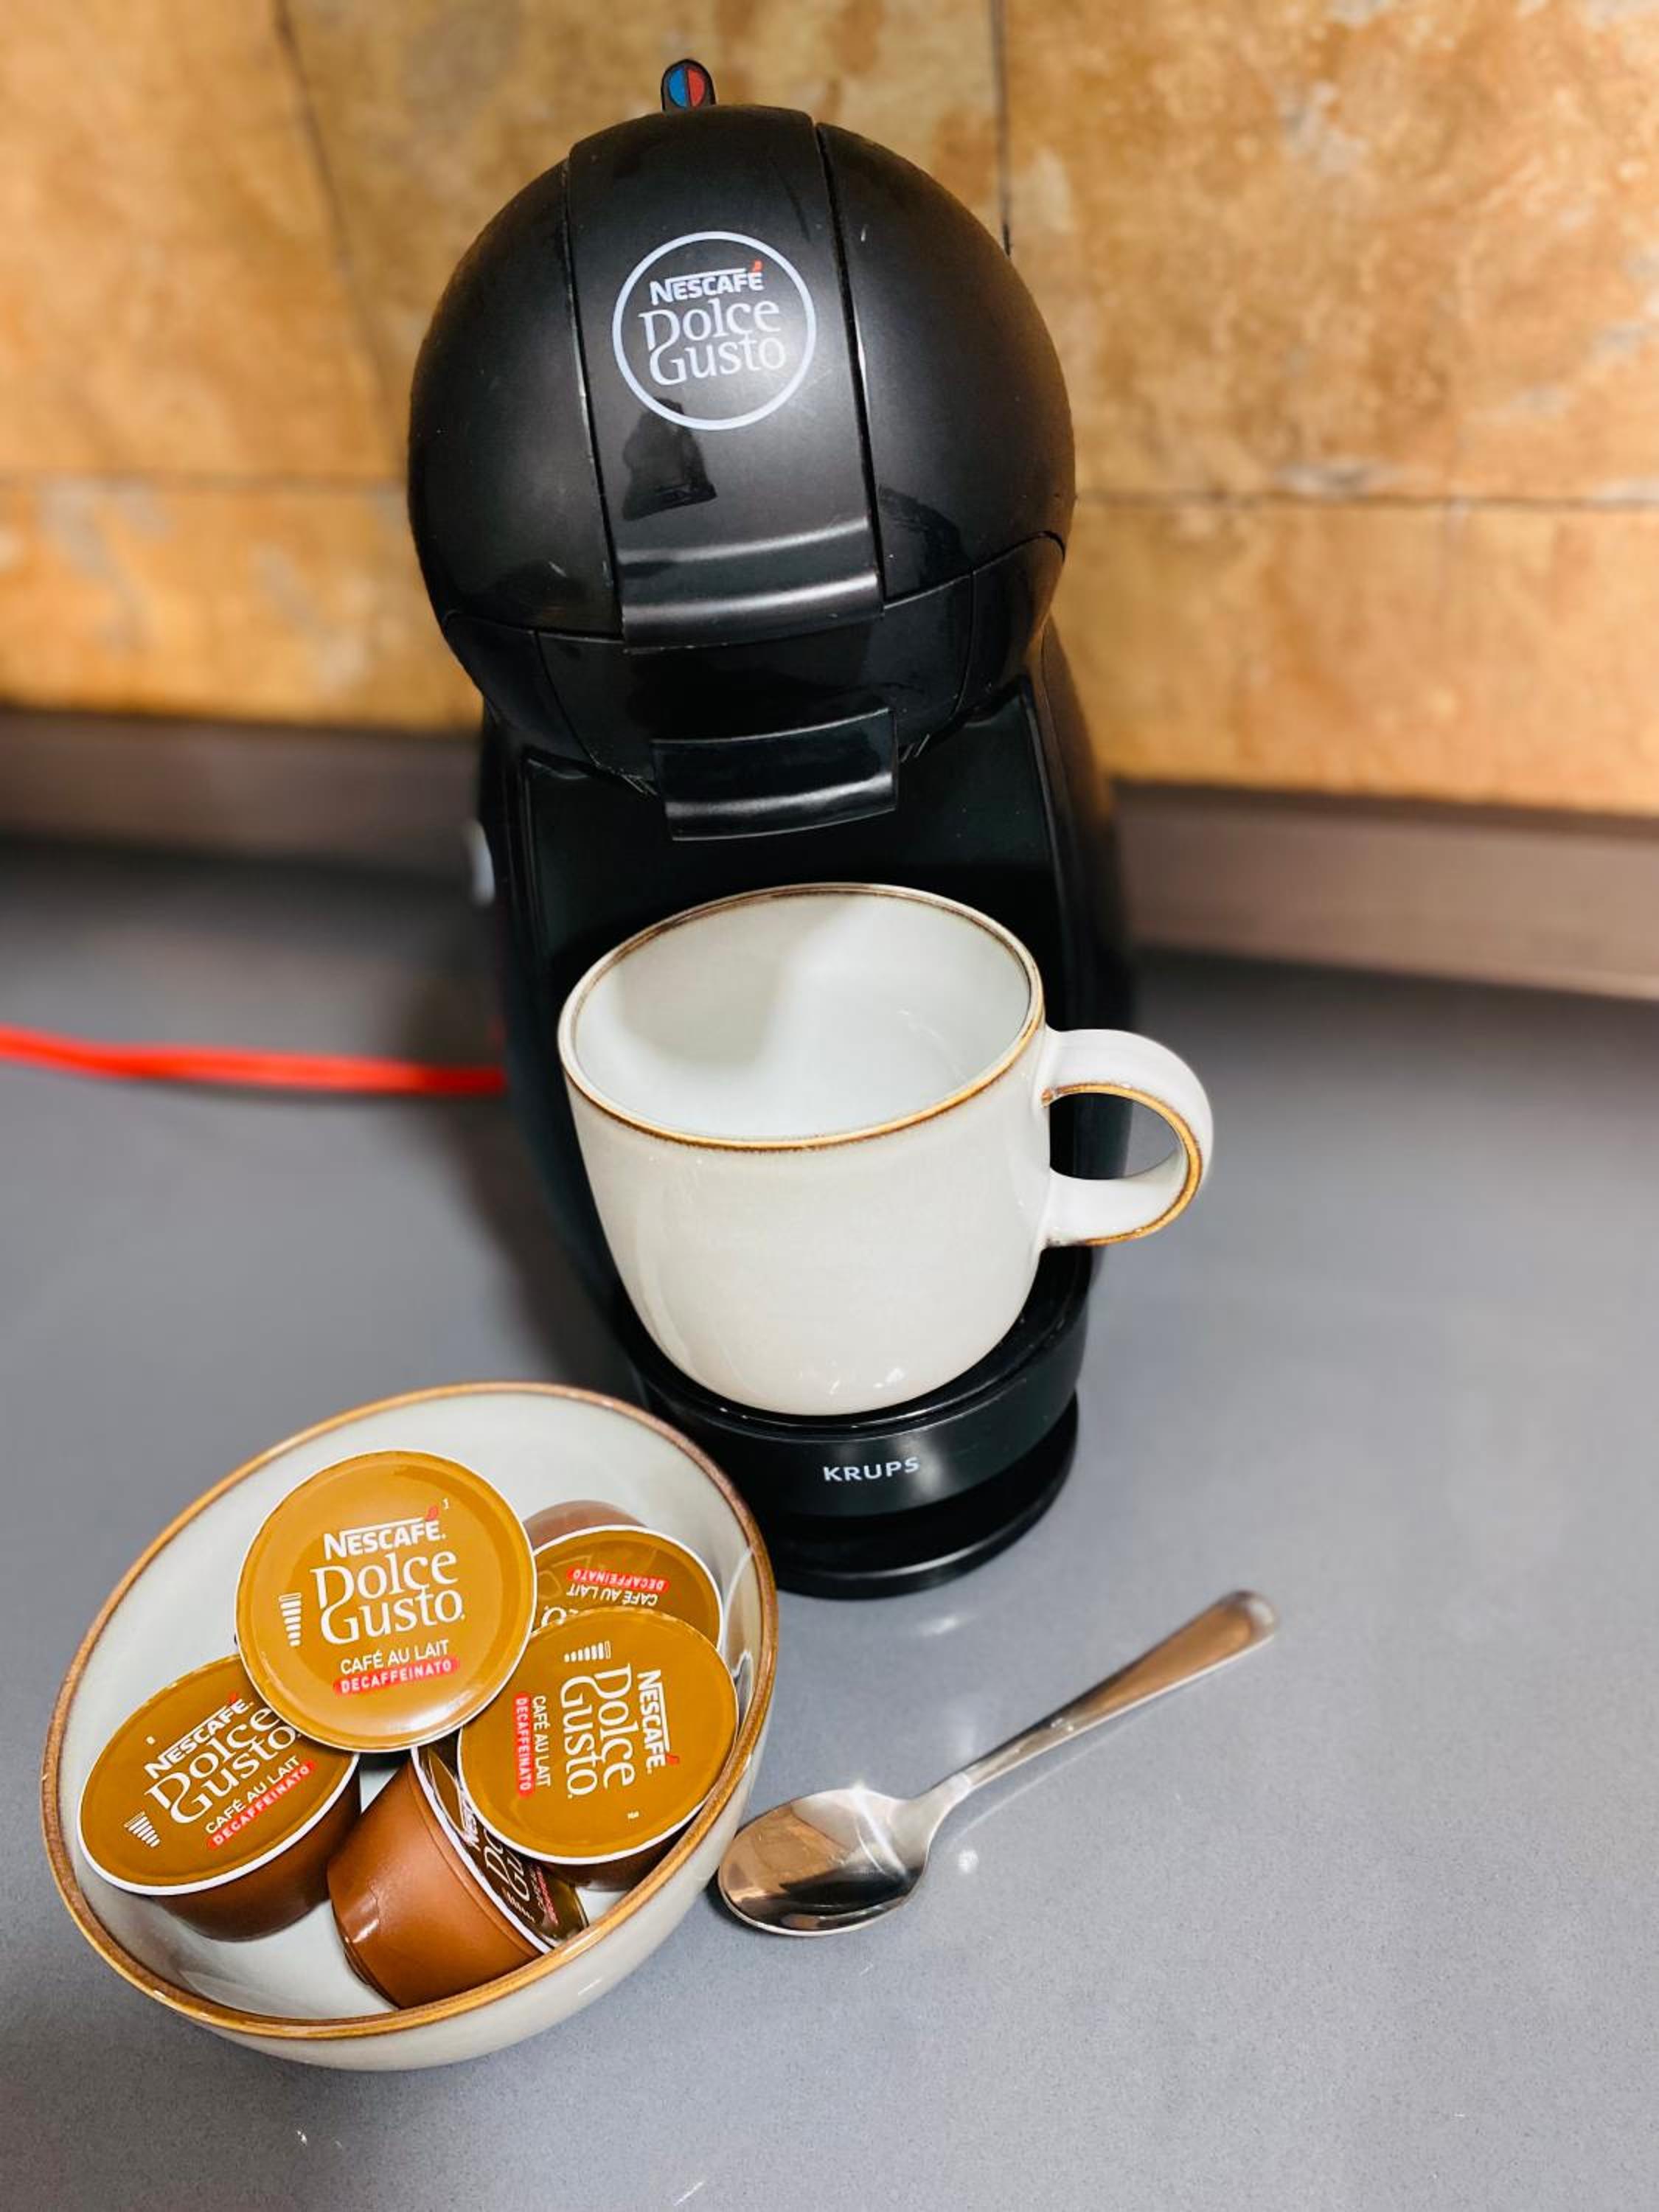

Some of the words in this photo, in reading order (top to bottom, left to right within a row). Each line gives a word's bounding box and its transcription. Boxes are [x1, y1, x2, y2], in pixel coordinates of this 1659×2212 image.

[639, 298, 781, 352] Dolce
[650, 335, 786, 386] Gusto
[823, 1456, 920, 1481] KRUPS
[310, 1551, 459, 1610] Dolce
[566, 1582, 596, 1600] LAIT
[594, 1586, 620, 1602] AU
[320, 1588, 465, 1646] Gusto
[341, 1649, 383, 1675] CAFÉ
[387, 1650, 410, 1666] AU
[414, 1639, 450, 1659] LAIT
[341, 1660, 452, 1693] DECAFFEINATO
[532, 1695, 551, 1731] CAFÉ
[560, 1676, 598, 1797] Gusto
[595, 1663, 636, 1789] Dolce
[144, 1706, 280, 1810] Dolce
[515, 1697, 532, 1792] DECAFFEINATO
[534, 1733, 549, 1753] AU
[170, 1725, 296, 1824] Gusto
[204, 1799, 246, 1834] CAFÉ
[246, 1781, 268, 1801] AU
[265, 1756, 300, 1784] LAIT
[535, 1756, 552, 1787] LAIT
[212, 1764, 312, 1846] DECAFFEINATO
